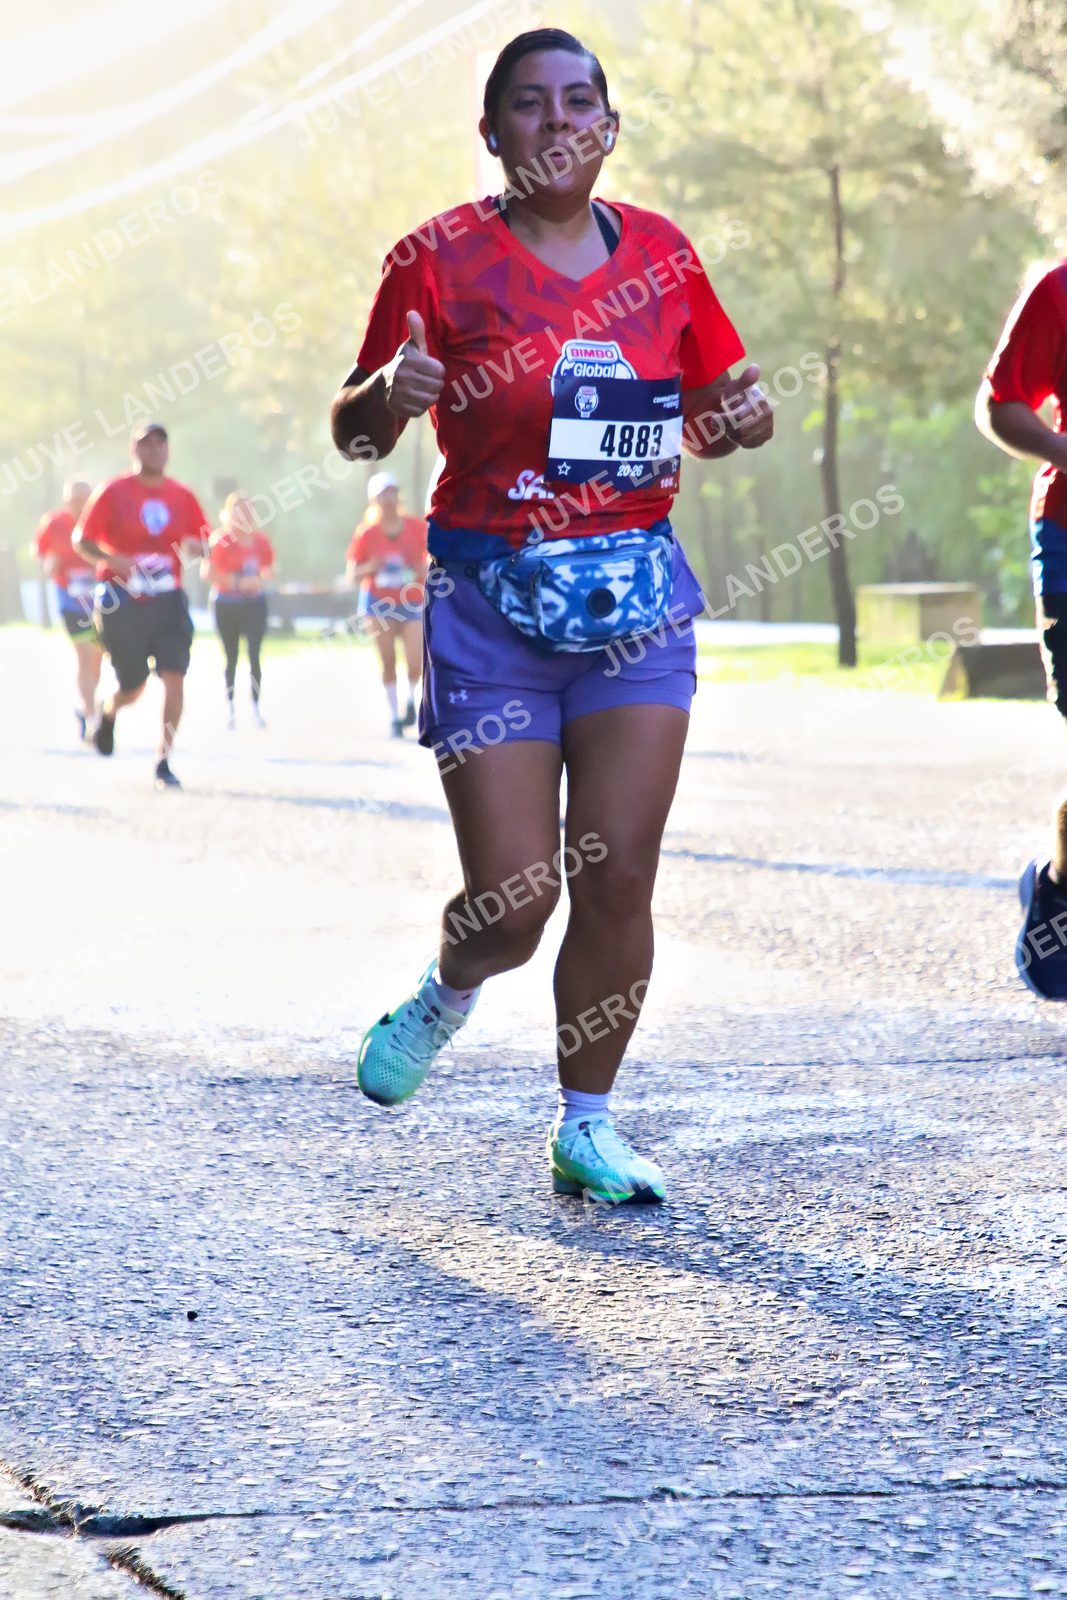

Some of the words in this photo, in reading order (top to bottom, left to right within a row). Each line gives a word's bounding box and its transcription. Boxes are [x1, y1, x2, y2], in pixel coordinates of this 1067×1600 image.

[570, 348, 615, 359] BIMBO
[573, 362, 616, 378] Global
[599, 423, 664, 459] 4883
[507, 469, 556, 500] SA
